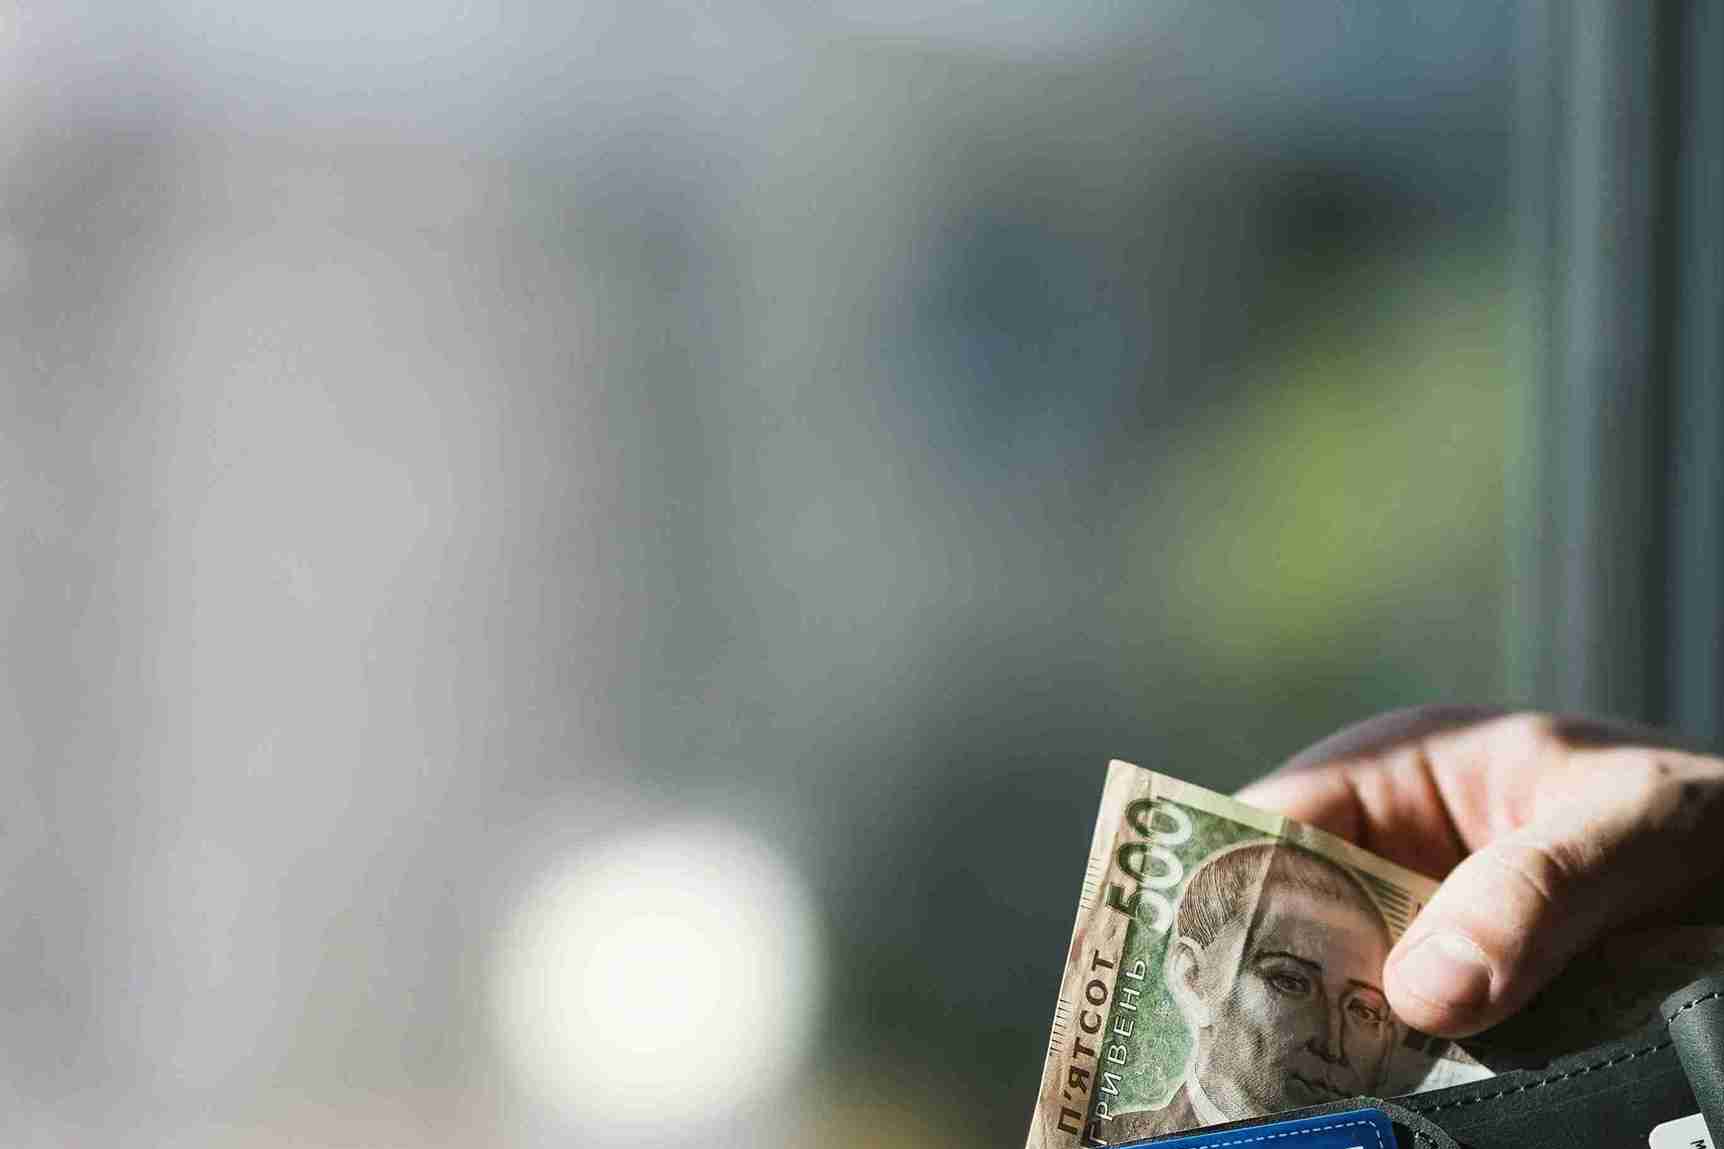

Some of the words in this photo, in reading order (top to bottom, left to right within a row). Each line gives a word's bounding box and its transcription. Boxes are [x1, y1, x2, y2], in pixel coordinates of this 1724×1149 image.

[1105, 797, 1193, 935] 500
[1057, 950, 1115, 1135] П'ЯТСОТ
[1088, 959, 1147, 1147] ГРИВЕНЬ
